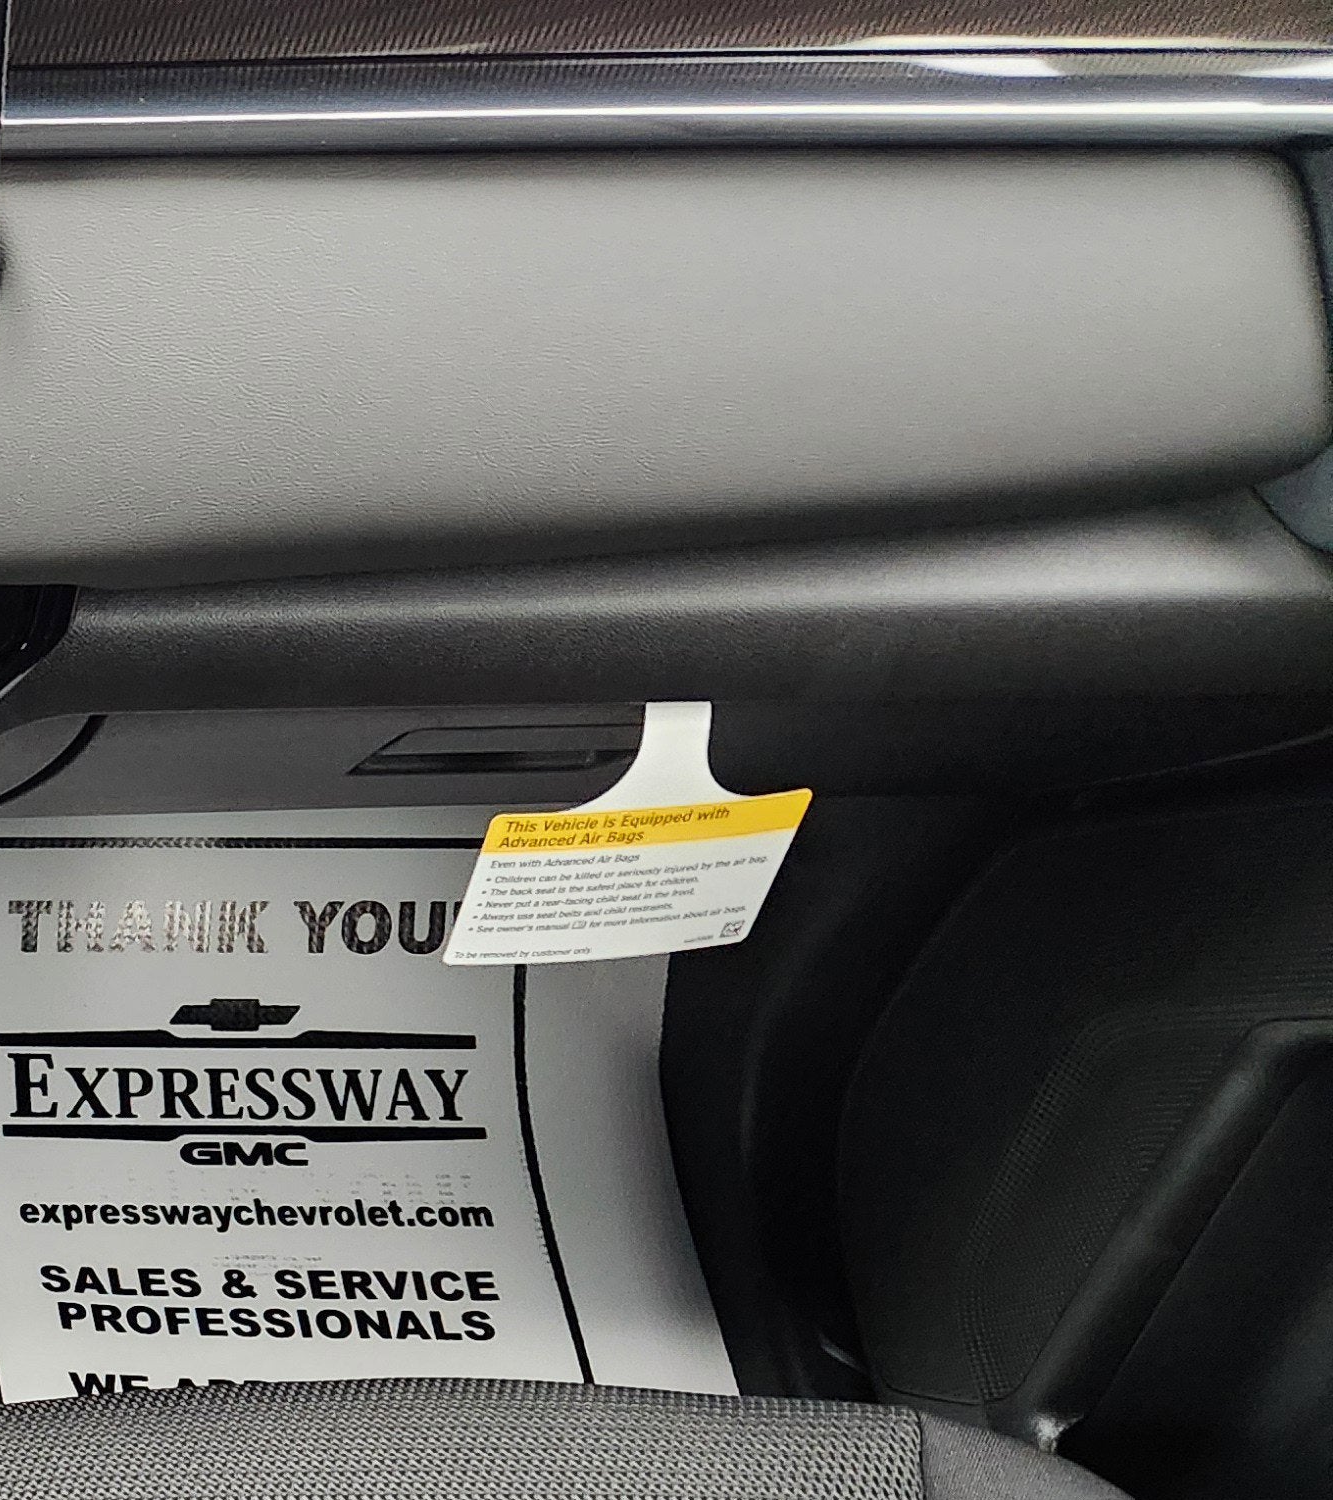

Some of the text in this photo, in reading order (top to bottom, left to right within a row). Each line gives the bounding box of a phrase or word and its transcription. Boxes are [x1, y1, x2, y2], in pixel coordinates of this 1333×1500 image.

[505, 820, 537, 833] This
[544, 819, 597, 832] Vehicle
[621, 810, 693, 828] Equipped
[697, 806, 730, 821] with
[498, 834, 576, 849] Advanced
[580, 832, 602, 845] Air
[490, 854, 640, 869] Even with Advanced Air Bags
[494, 875, 537, 884] Children
[559, 873, 572, 881] be
[574, 871, 603, 880] killed
[617, 867, 662, 878] seriously
[664, 863, 699, 874] injured
[700, 862, 713, 871] by
[714, 860, 731, 869] the
[485, 900, 514, 908] Never
[514, 900, 532, 909] put
[490, 888, 508, 896] The
[510, 888, 532, 896] back
[535, 887, 556, 895] seat
[8, 899, 270, 954] THANK
[180, 1141, 309, 1167] GMC
[19, 1198, 495, 1233] expresswaychevrolet.com
[39, 1265, 501, 1302] SALES & SERVICE
[58, 1301, 496, 1342] PROFESSIONALS
